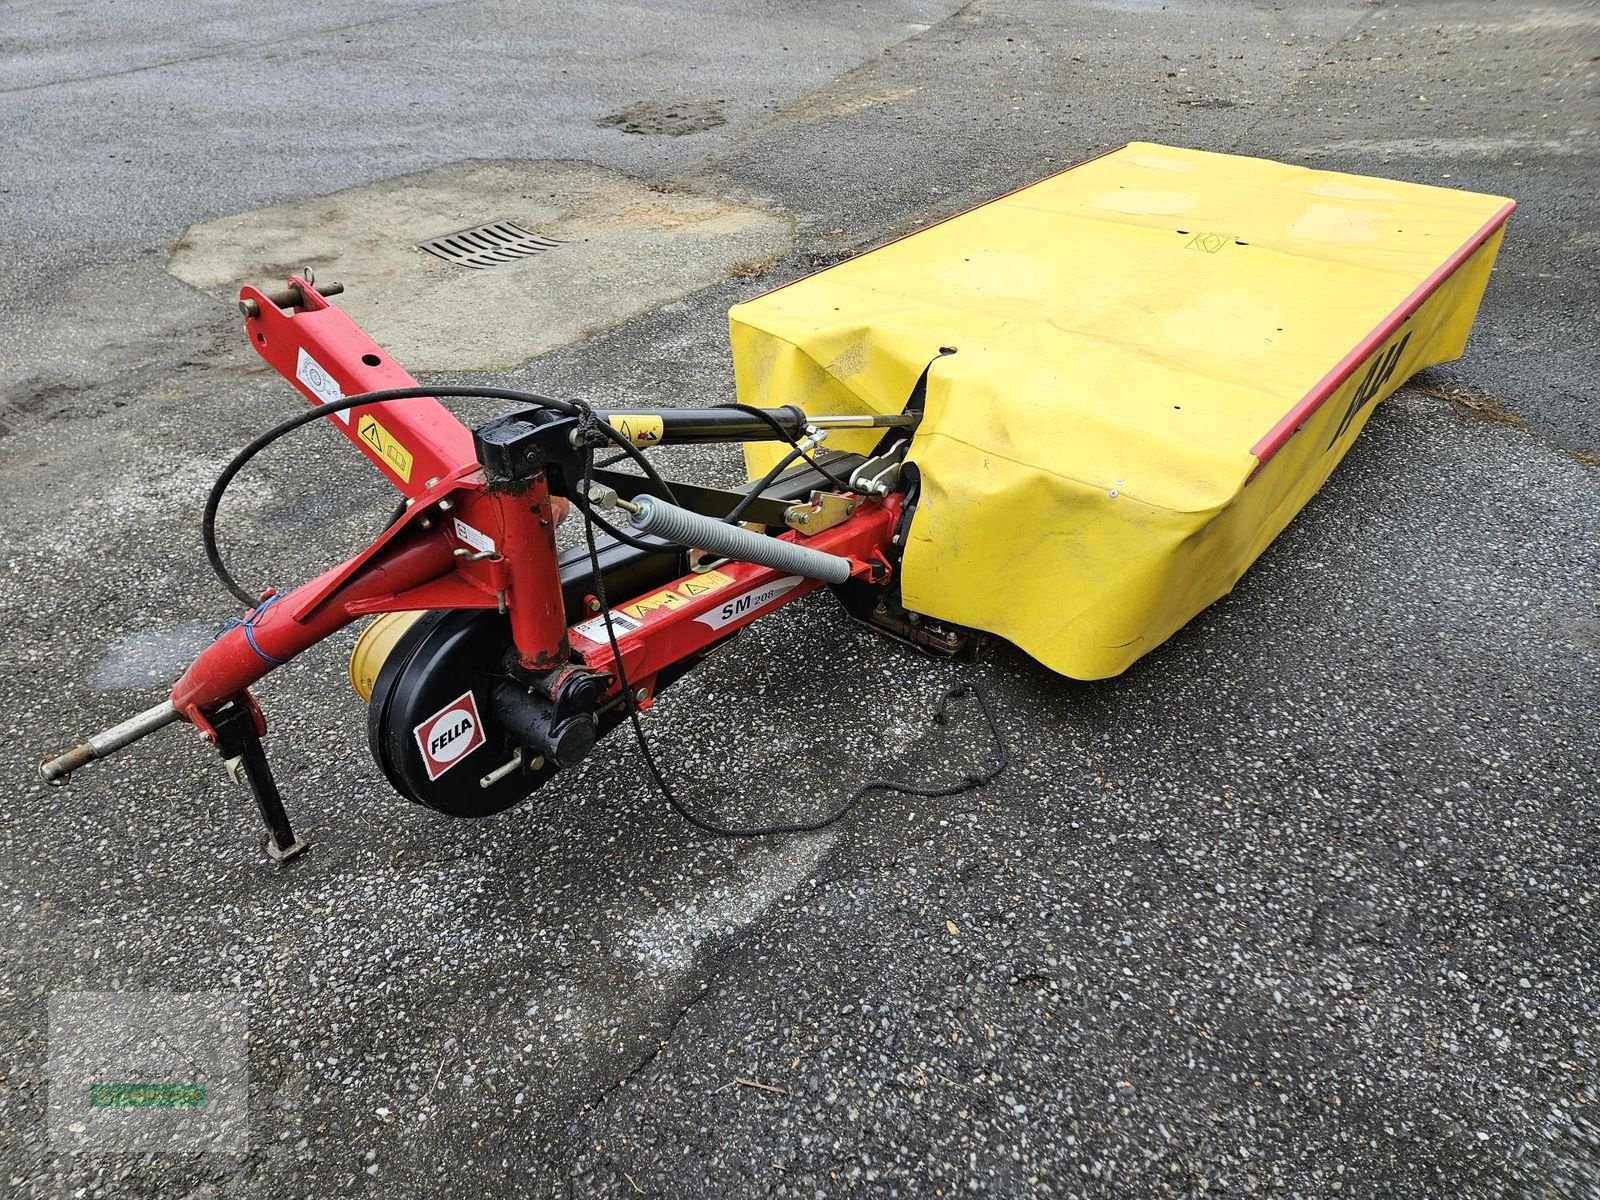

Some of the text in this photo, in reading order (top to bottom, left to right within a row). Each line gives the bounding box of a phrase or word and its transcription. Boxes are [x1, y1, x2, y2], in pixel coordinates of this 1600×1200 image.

[721, 589, 775, 621] SM 208
[431, 717, 473, 756] FELLA
